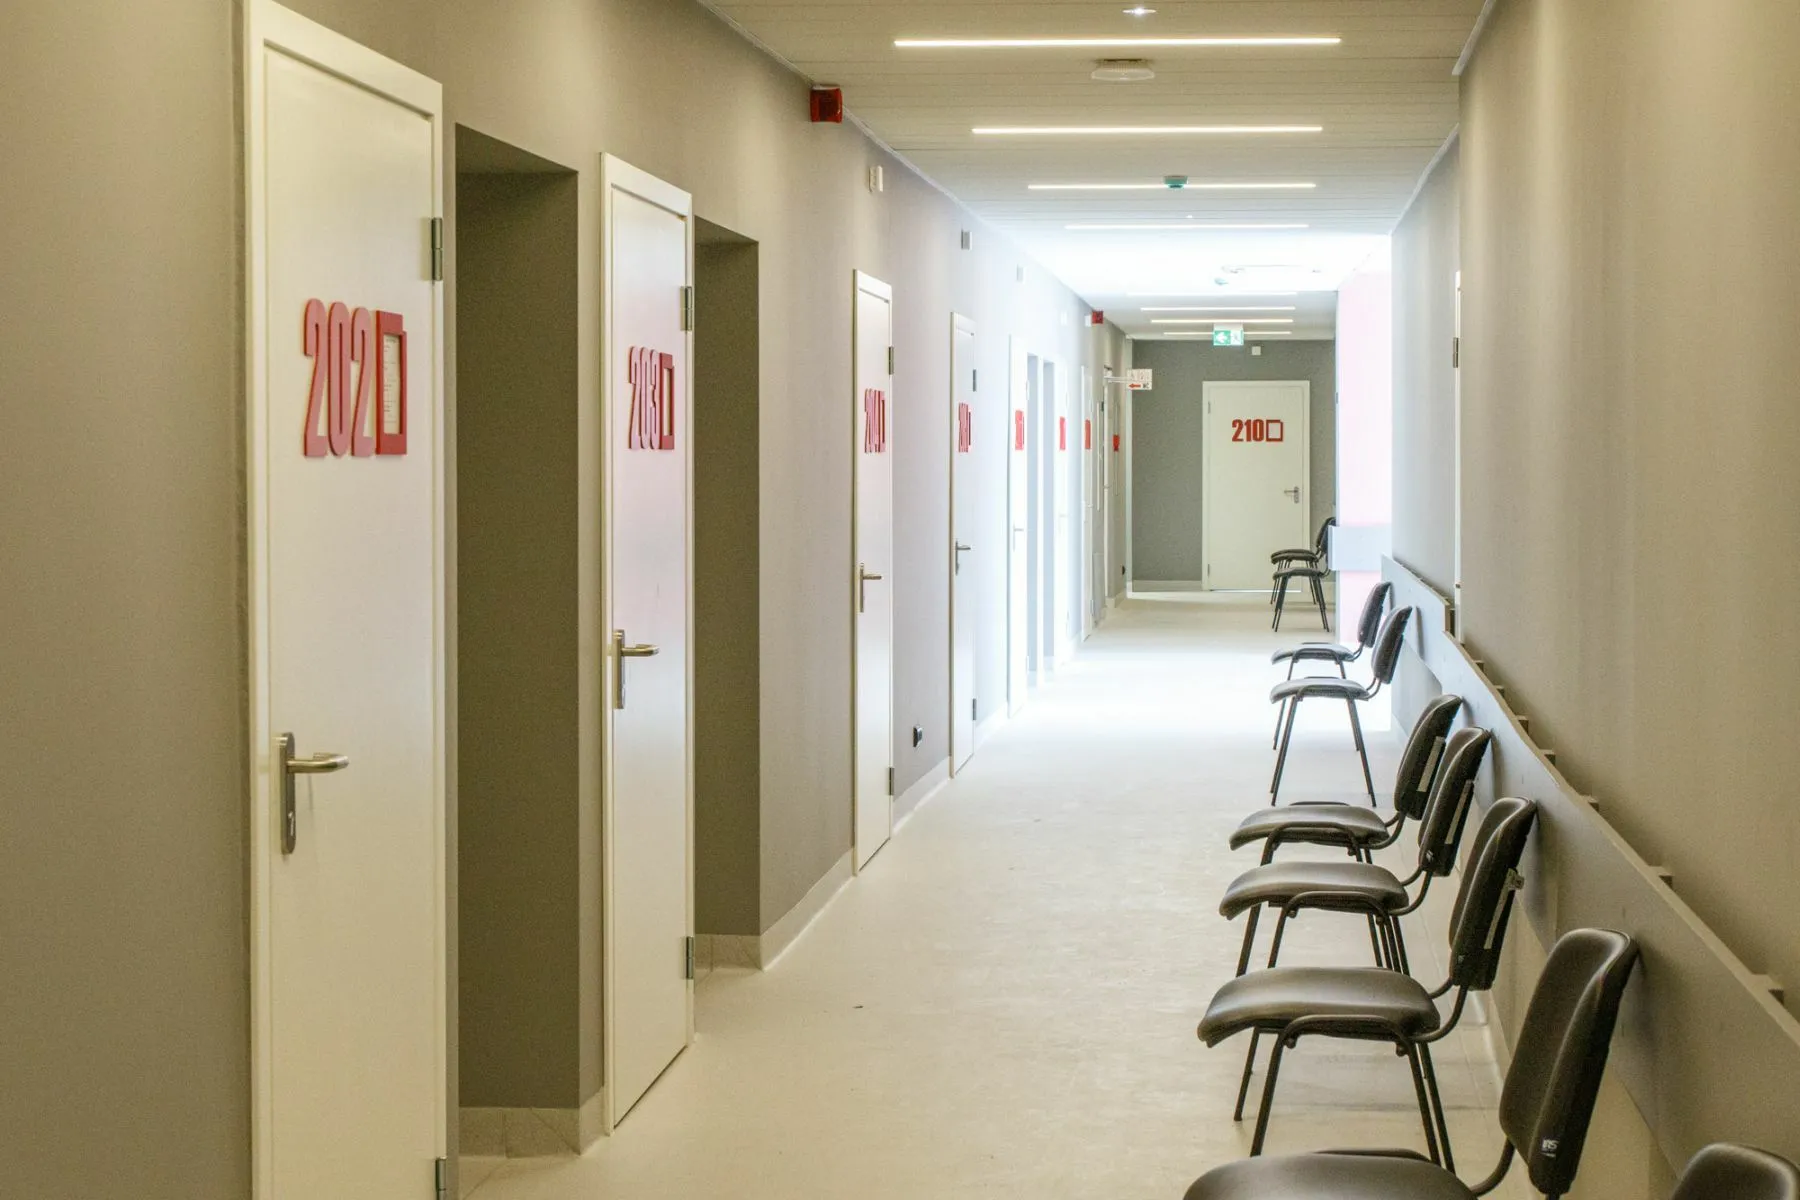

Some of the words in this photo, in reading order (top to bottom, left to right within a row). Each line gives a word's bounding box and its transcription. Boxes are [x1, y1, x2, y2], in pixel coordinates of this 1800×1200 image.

[303, 298, 375, 457] 202
[628, 346, 660, 450] 203
[1231, 418, 1264, 442] 210
